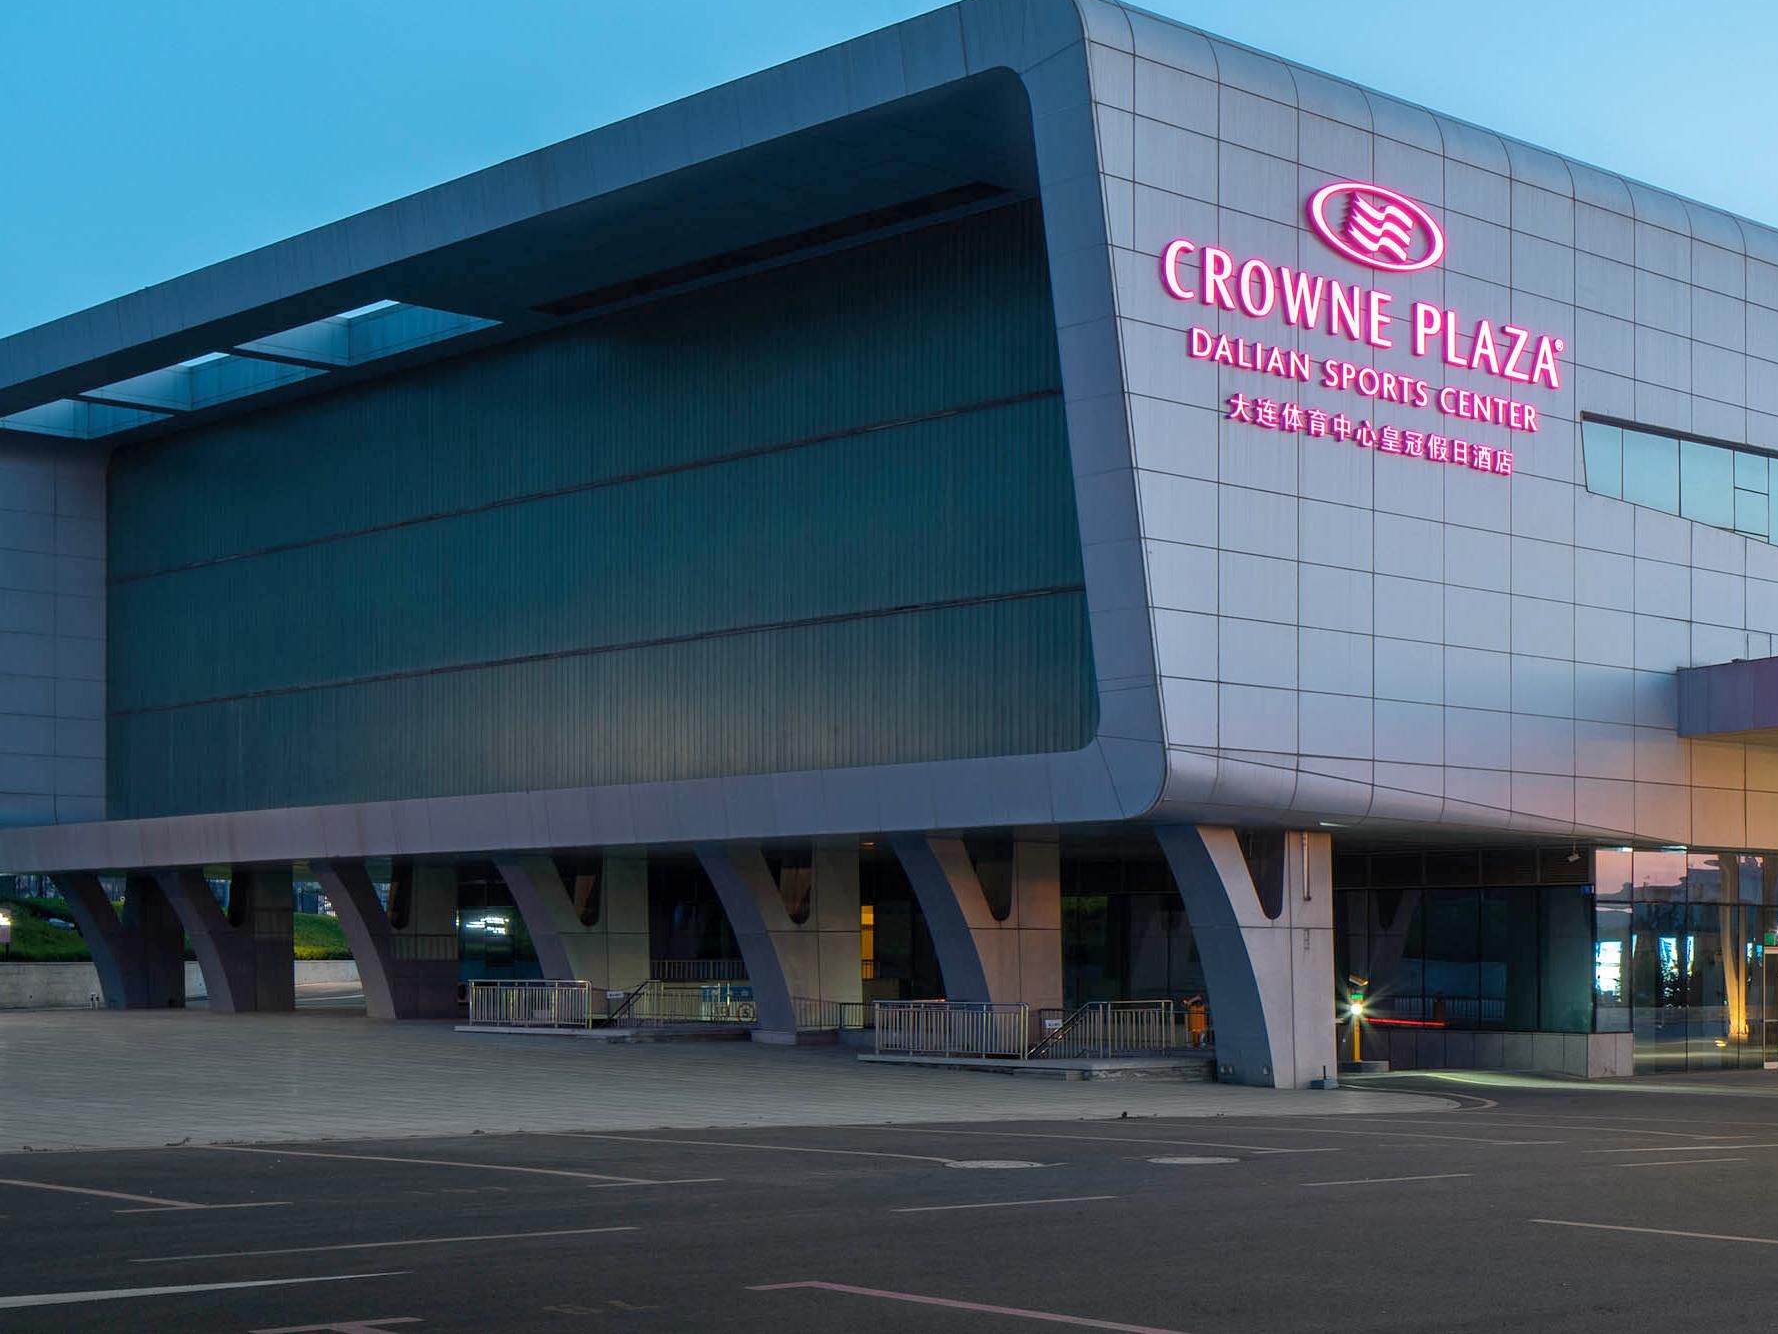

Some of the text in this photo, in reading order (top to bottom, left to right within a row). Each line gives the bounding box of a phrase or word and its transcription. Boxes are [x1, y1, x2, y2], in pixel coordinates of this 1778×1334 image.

[1161, 237, 1393, 350] CROWNE
[1188, 327, 1540, 433] DALIAN SPORTS CENTER
[1226, 393, 1515, 476] 大连体育中心皇冠假日酒店
